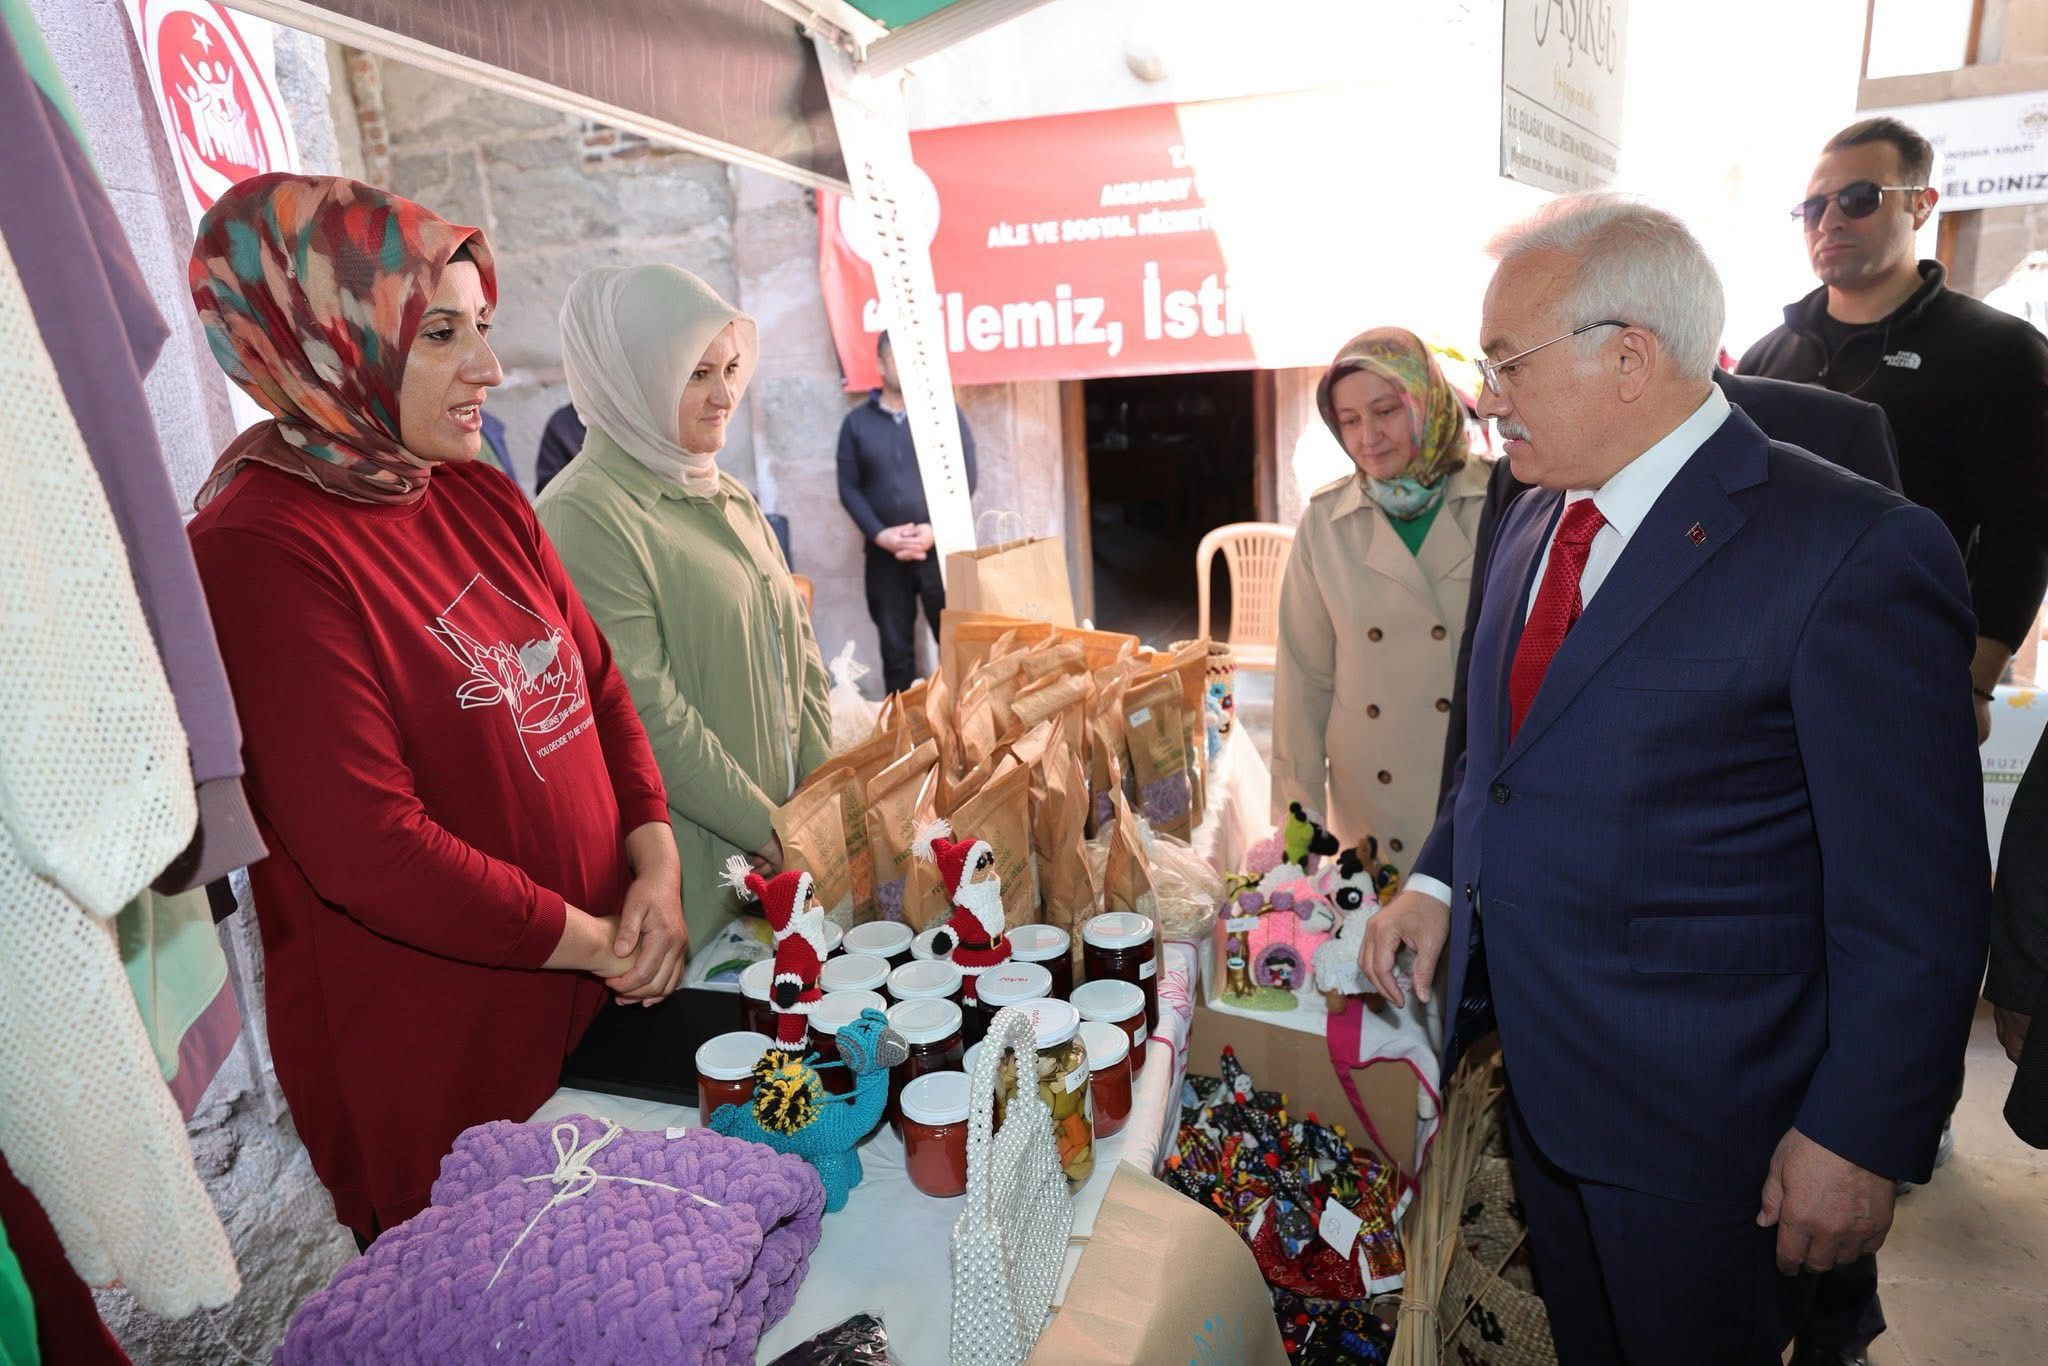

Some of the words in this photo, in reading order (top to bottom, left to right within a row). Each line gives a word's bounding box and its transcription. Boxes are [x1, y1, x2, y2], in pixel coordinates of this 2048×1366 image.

[1945, 174, 2048, 197] ELDİNİZ
[1032, 221, 1059, 244] VE
[1143, 261, 1245, 340] İsti
[537, 745, 549, 758] YOU
[548, 734, 568, 752] DECIDE
[566, 730, 575, 741] TO
[573, 724, 582, 736] BE
